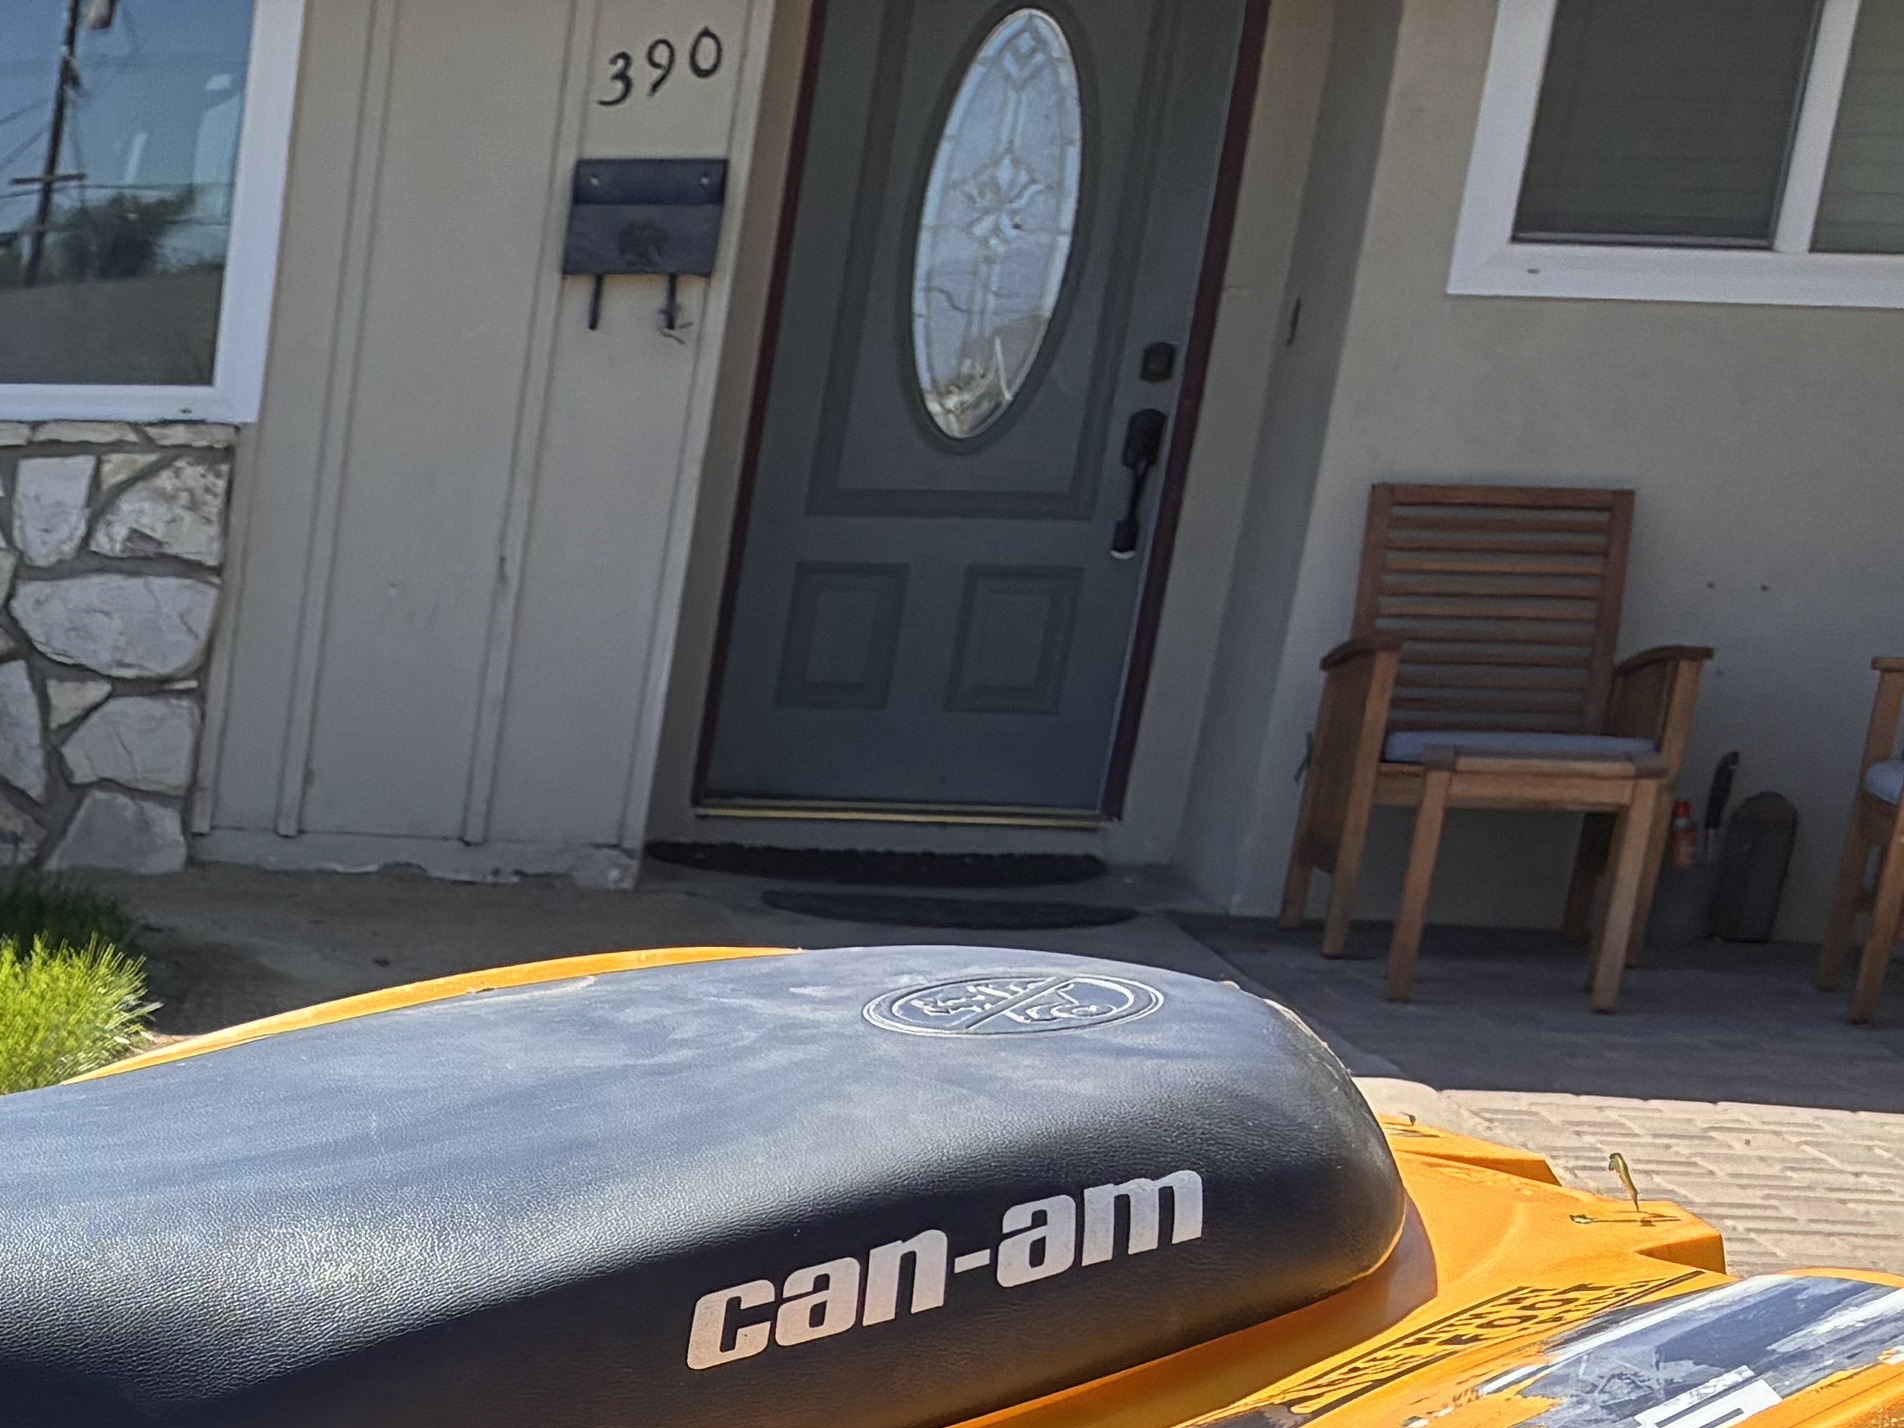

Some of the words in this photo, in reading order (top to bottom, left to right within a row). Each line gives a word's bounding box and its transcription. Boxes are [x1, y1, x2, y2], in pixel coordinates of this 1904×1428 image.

[596, 26, 723, 107] 390
[686, 1169, 1204, 1371] can-am
[1430, 1281, 1624, 1346] FOOT
